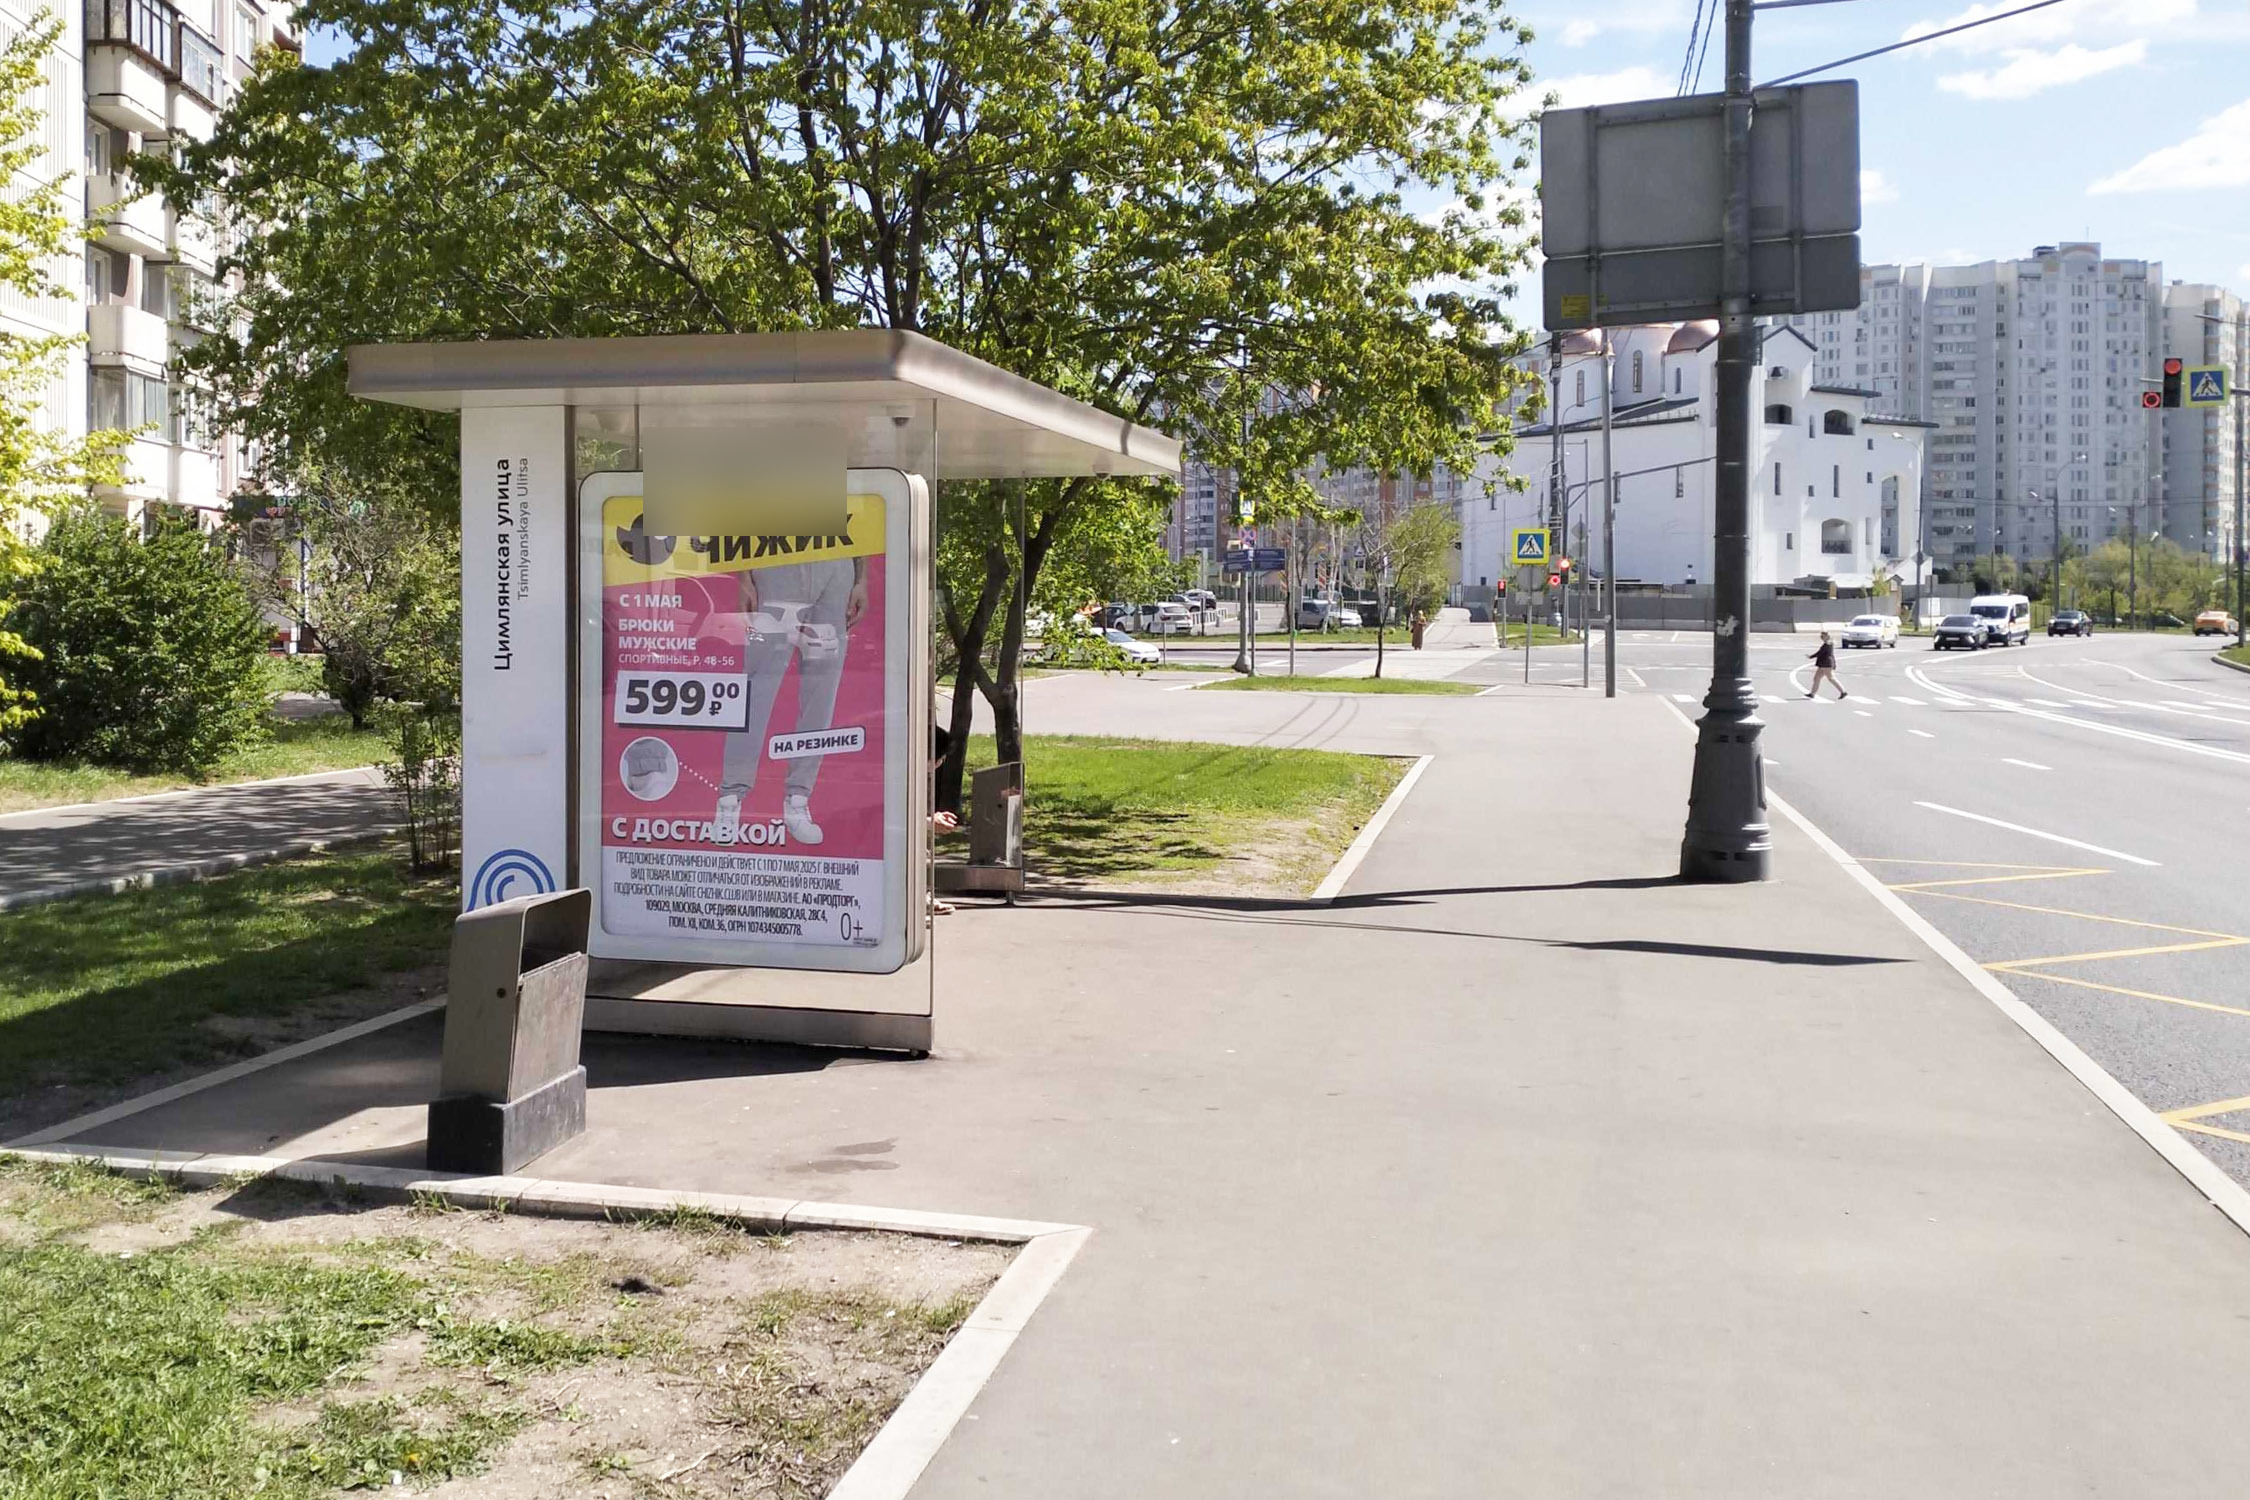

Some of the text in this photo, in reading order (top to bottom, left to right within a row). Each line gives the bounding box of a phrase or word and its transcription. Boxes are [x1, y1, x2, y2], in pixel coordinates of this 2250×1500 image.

[517, 457, 531, 600] Tsimlyanskaya Ulitsa
[494, 458, 513, 670] Цимлянская улица
[620, 594, 682, 608] С 1 МАЯ
[618, 618, 674, 632] БРЮКИ
[618, 636, 697, 650] МУЖСКИЕ
[704, 655, 735, 666] 48-56
[625, 679, 740, 716] 599 00
[774, 734, 858, 753] НА РЕЗИНКЕ
[612, 817, 786, 846] С ДОСТАВКОЙ
[616, 851, 666, 865] ПРЕДЛОЖЕНИЕ
[667, 854, 711, 868] ОГРАНИЧЕНО
[718, 855, 756, 871] ДЕЙСТВУЕТ
[783, 861, 800, 873] МАЯ
[800, 862, 817, 874] 2025
[823, 861, 859, 876] ВНЕШНИЙ
[630, 868, 645, 881] ВИД
[646, 868, 671, 881] ТОВАРА
[672, 870, 697, 883] МОЖЕТ
[697, 871, 740, 885] ОТЛИЧАТЬСЯ
[740, 873, 750, 885] ОТ
[750, 874, 802, 889] ИЗОБРАЖЕНИЙ
[803, 879, 808, 889] В
[614, 881, 664, 896] ПОДРОБНОСТИ
[665, 885, 675, 896] НА
[675, 883, 696, 898] САЙТЕ
[741, 889, 757, 901] ИЛИ
[802, 893, 812, 904] АО
[646, 899, 672, 914] 109029,
[672, 901, 704, 916] МОСКВА,
[704, 903, 736, 917] СРЕДНЯЯ
[727, 920, 746, 933] ОГРН
[840, 912, 864, 940] 0+
